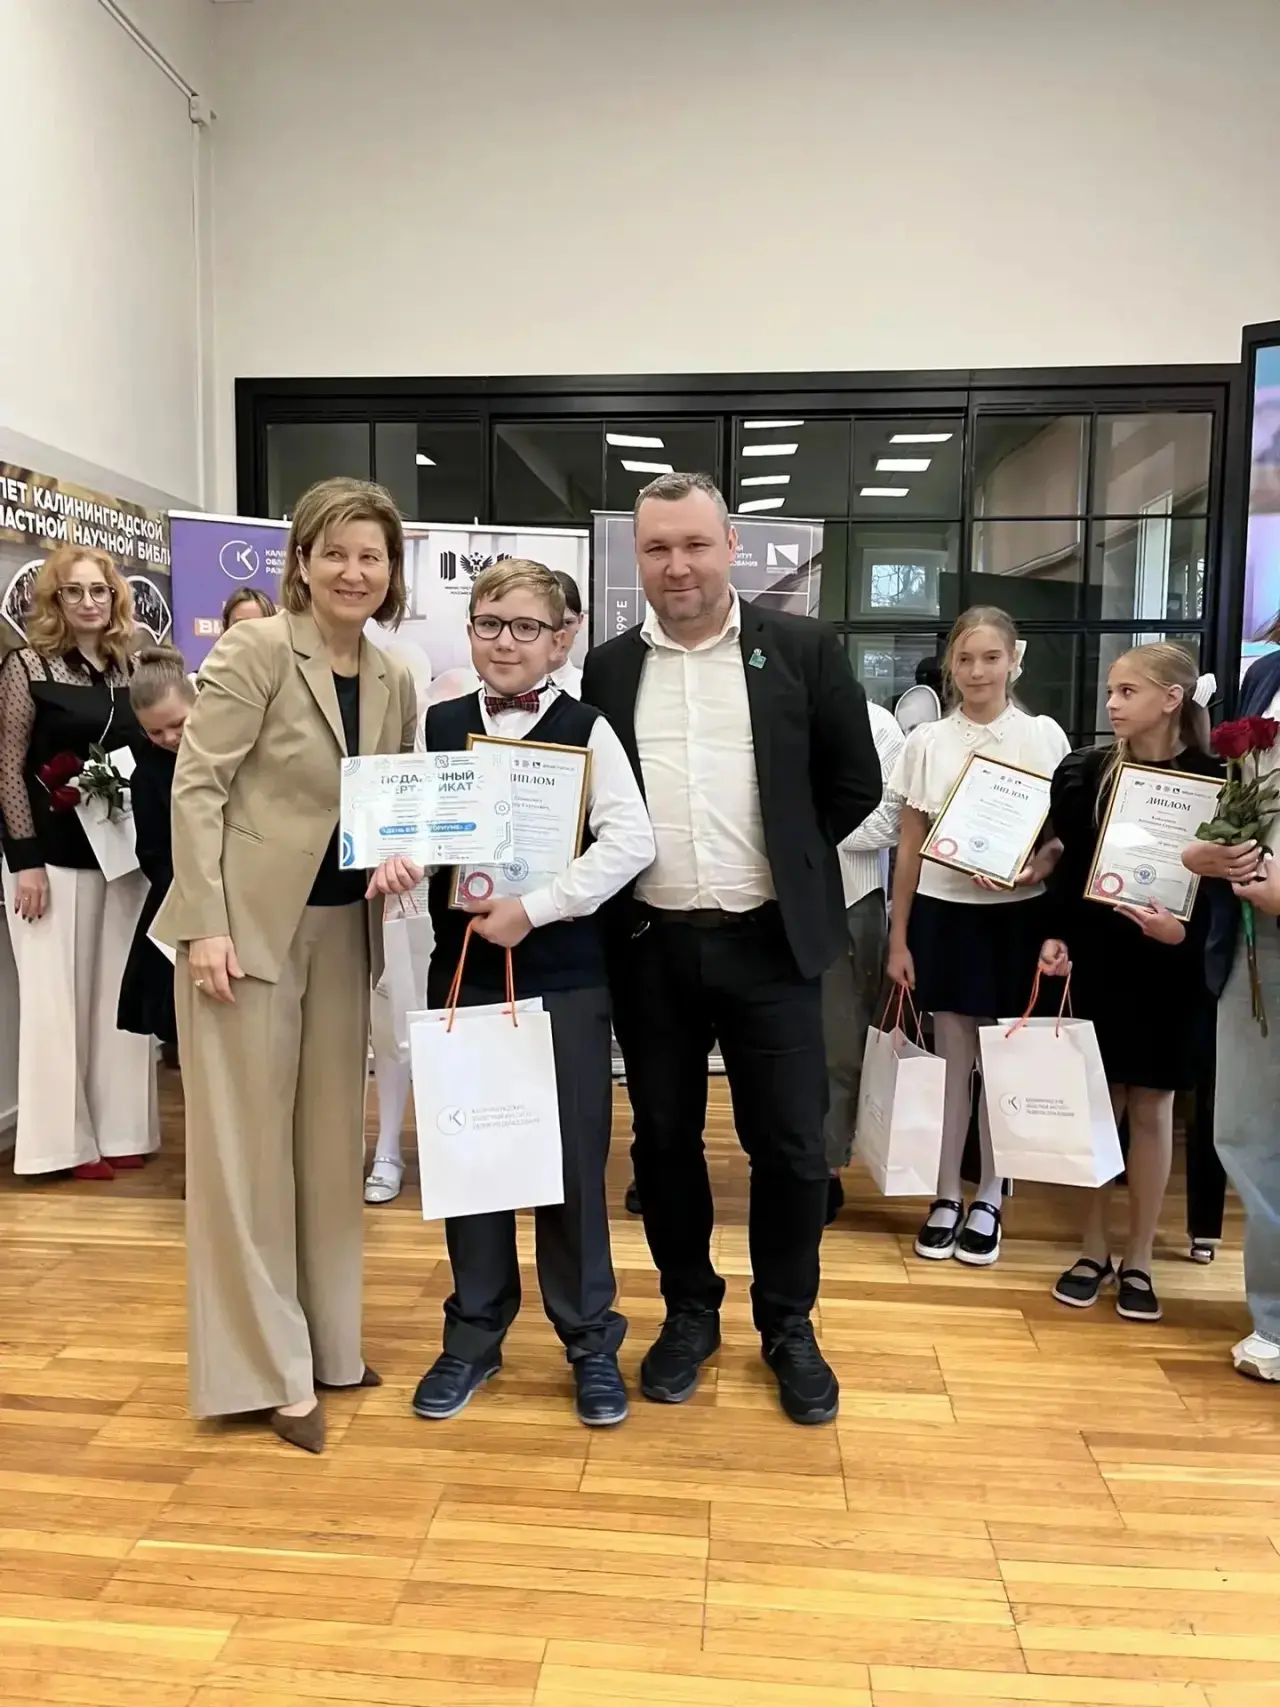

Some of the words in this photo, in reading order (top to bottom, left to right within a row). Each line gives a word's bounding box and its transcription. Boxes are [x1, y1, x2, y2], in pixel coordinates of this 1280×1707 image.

[33, 485, 163, 542] КАЛИНИНГРАДСКОЙ
[72, 523, 134, 557] НАУЧНОЙ
[1145, 796, 1192, 812] ДИПЛОМ
